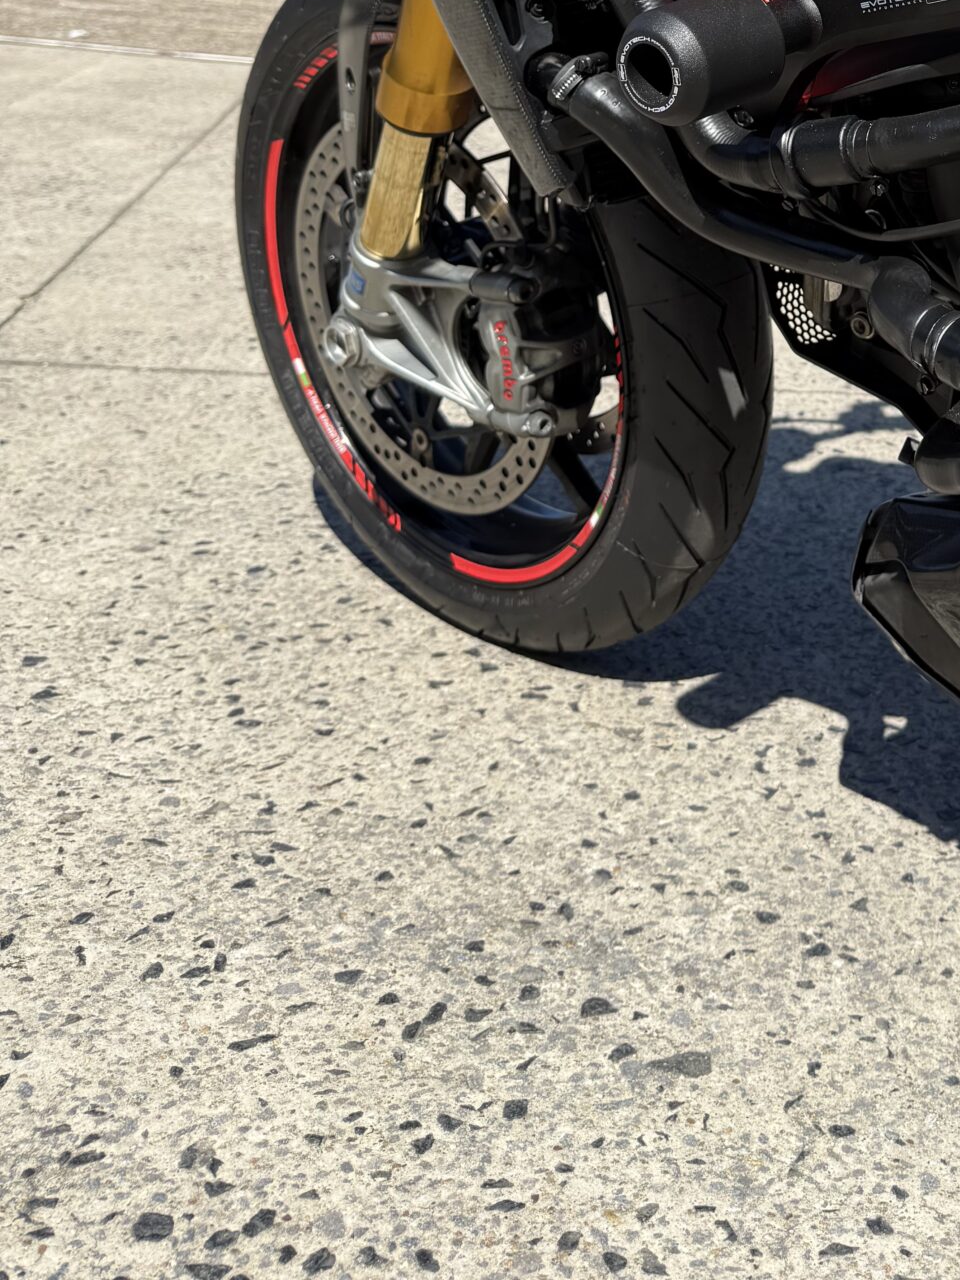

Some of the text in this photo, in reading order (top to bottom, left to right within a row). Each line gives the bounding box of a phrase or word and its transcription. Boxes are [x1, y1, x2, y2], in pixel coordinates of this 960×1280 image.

[620, 36, 651, 63] EVOTECH
[647, 86, 679, 113] EVOTECH
[494, 320, 517, 401] brembo
